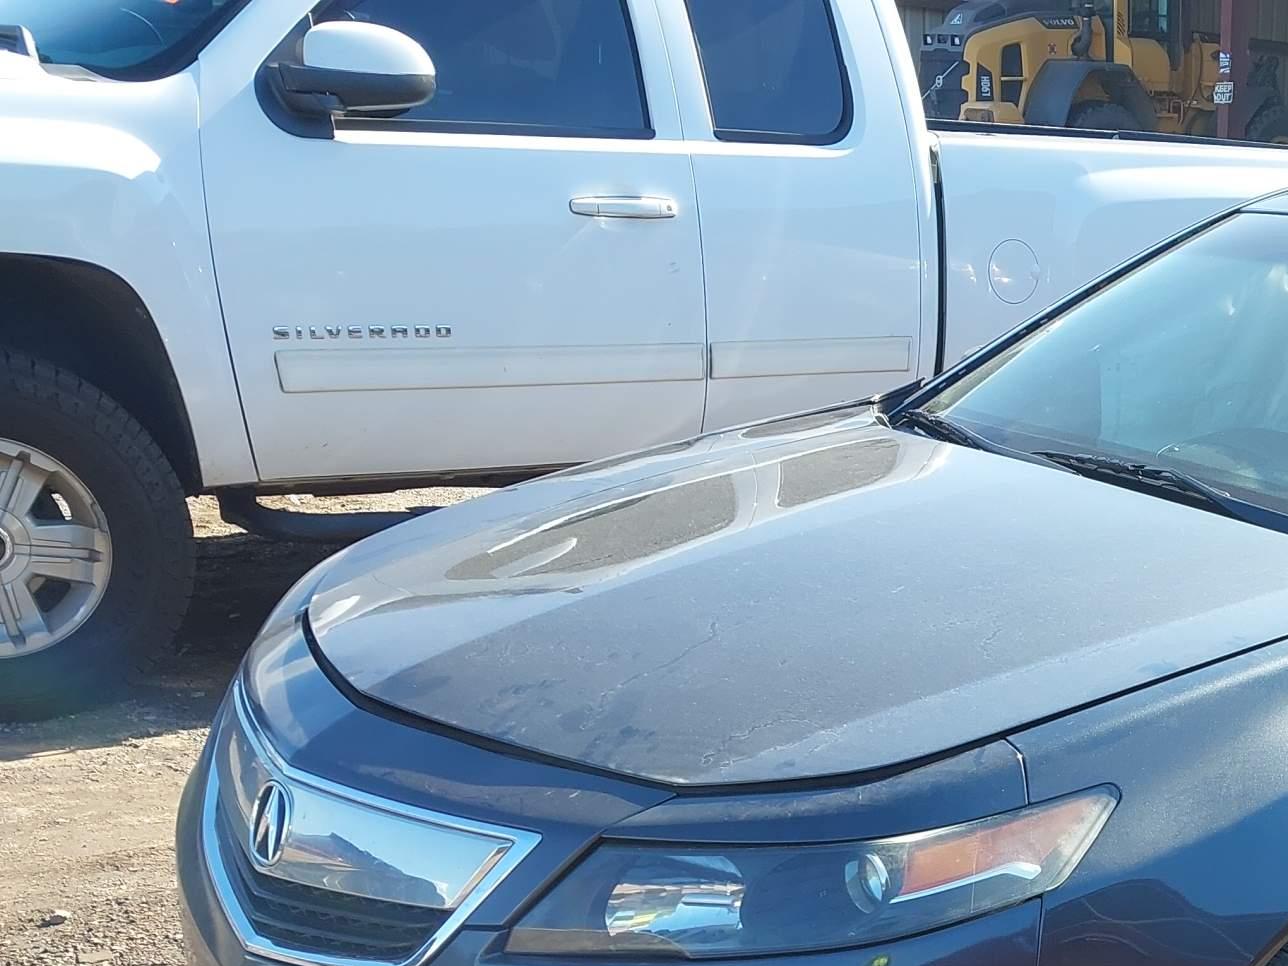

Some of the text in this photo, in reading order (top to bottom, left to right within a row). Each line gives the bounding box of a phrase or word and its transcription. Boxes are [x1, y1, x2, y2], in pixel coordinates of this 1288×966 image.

[980, 75, 991, 97] L90H
[1215, 84, 1232, 92] KEEP
[1216, 93, 1231, 101] OUT
[272, 325, 452, 340] SILVERADO
